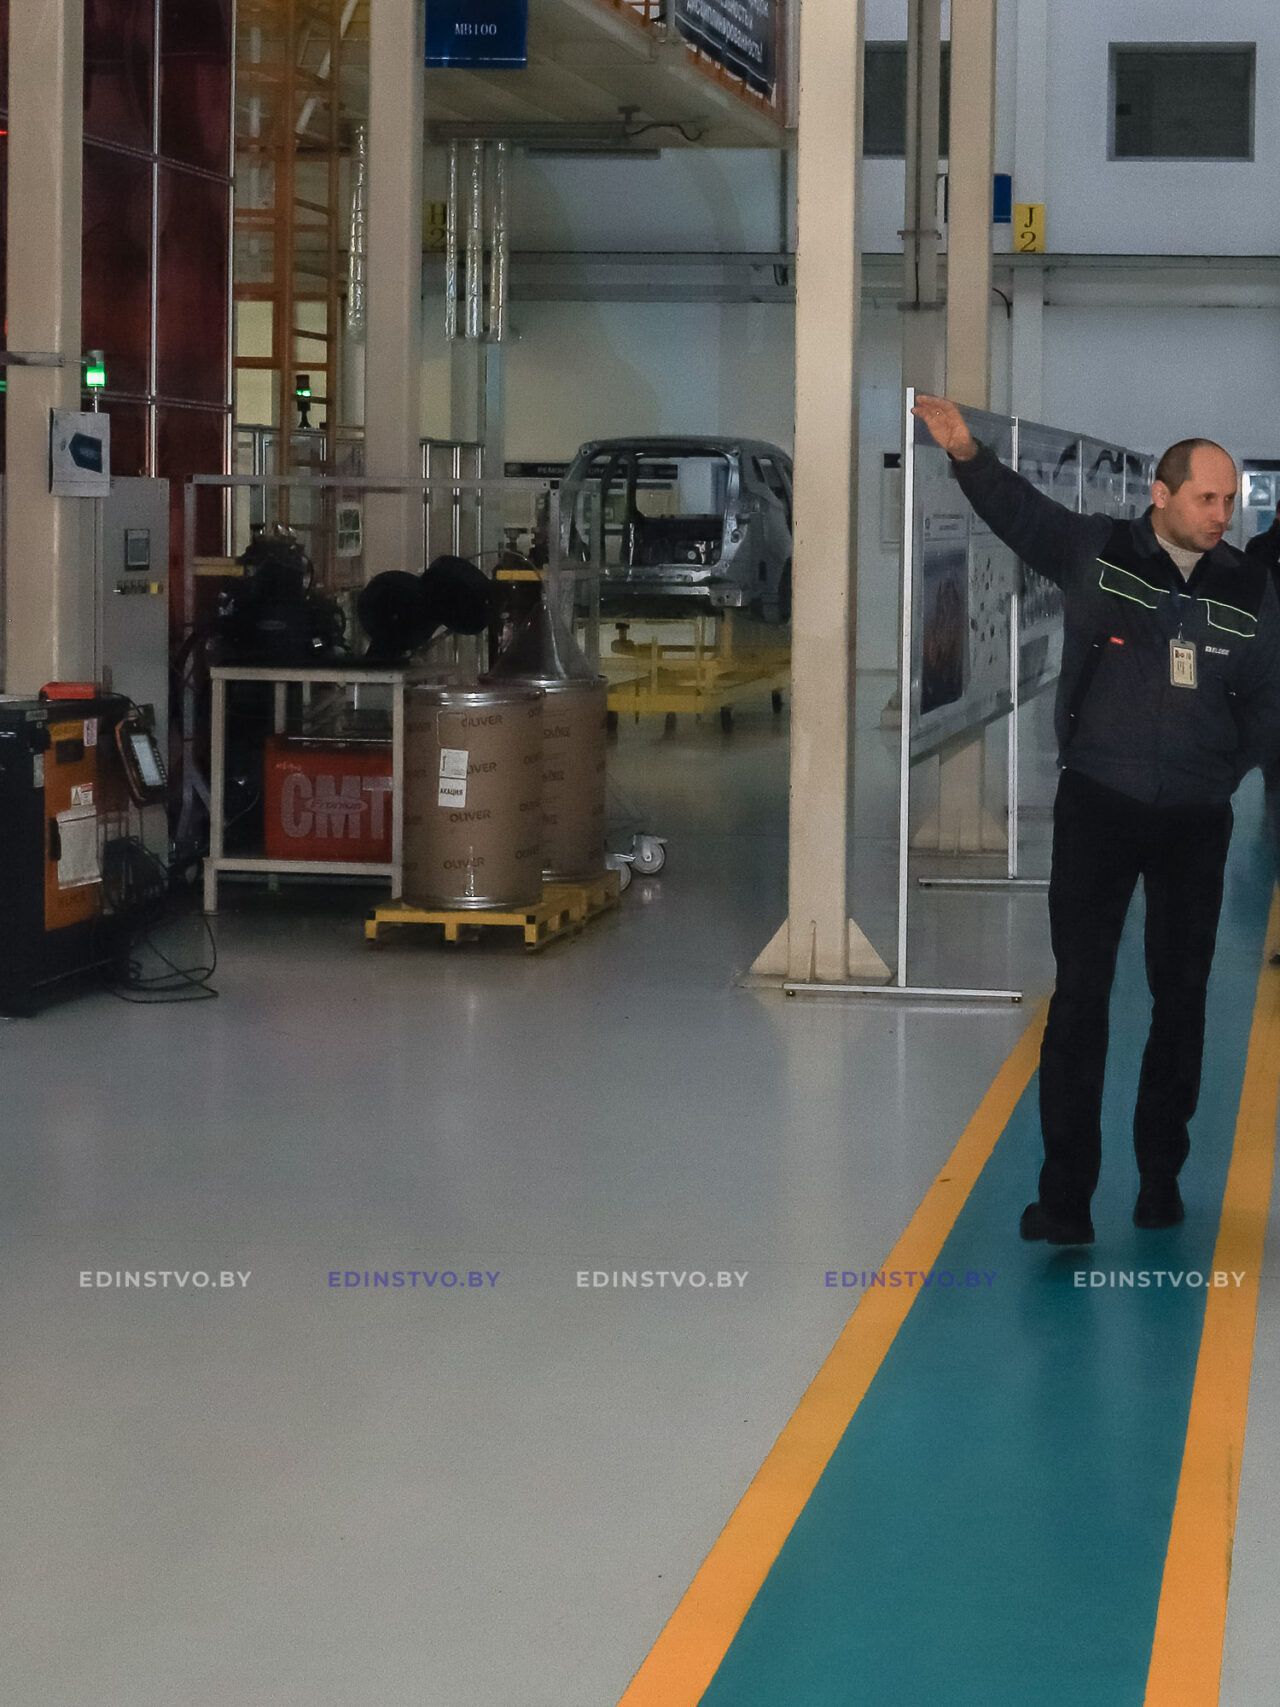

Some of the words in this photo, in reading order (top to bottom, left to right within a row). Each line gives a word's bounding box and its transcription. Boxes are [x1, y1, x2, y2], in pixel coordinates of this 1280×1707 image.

[454, 23, 497, 36] MB100
[1023, 206, 1034, 228] J
[1020, 231, 1036, 252] 2
[461, 714, 503, 728] OLIVER
[440, 788, 463, 797] АКАЦИЯ
[280, 773, 393, 839] CMT
[449, 809, 491, 823] OLIVER
[443, 856, 485, 870] OLIVER
